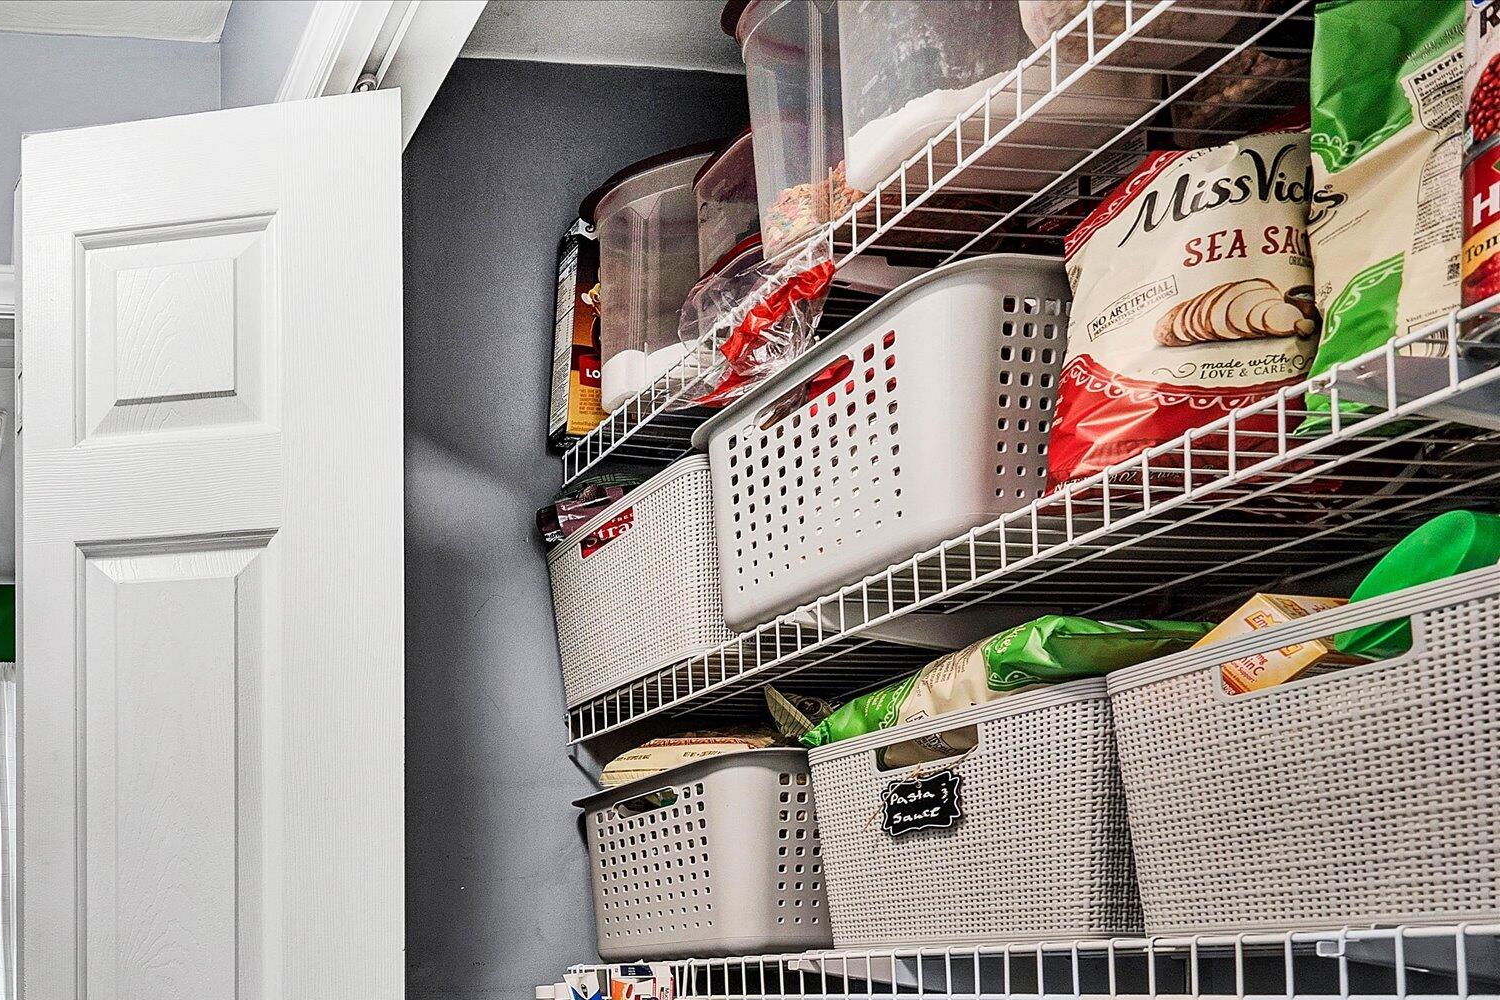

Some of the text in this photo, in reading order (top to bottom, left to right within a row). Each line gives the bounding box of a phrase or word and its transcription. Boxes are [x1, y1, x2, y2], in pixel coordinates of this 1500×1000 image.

[1183, 229, 1247, 268] SEA
[1092, 281, 1173, 331] NO ARTIFICIAL
[1200, 353, 1291, 370] made with
[1200, 368, 1234, 380] LOVE
[1239, 367, 1248, 377] &
[890, 789, 936, 806] Pasta
